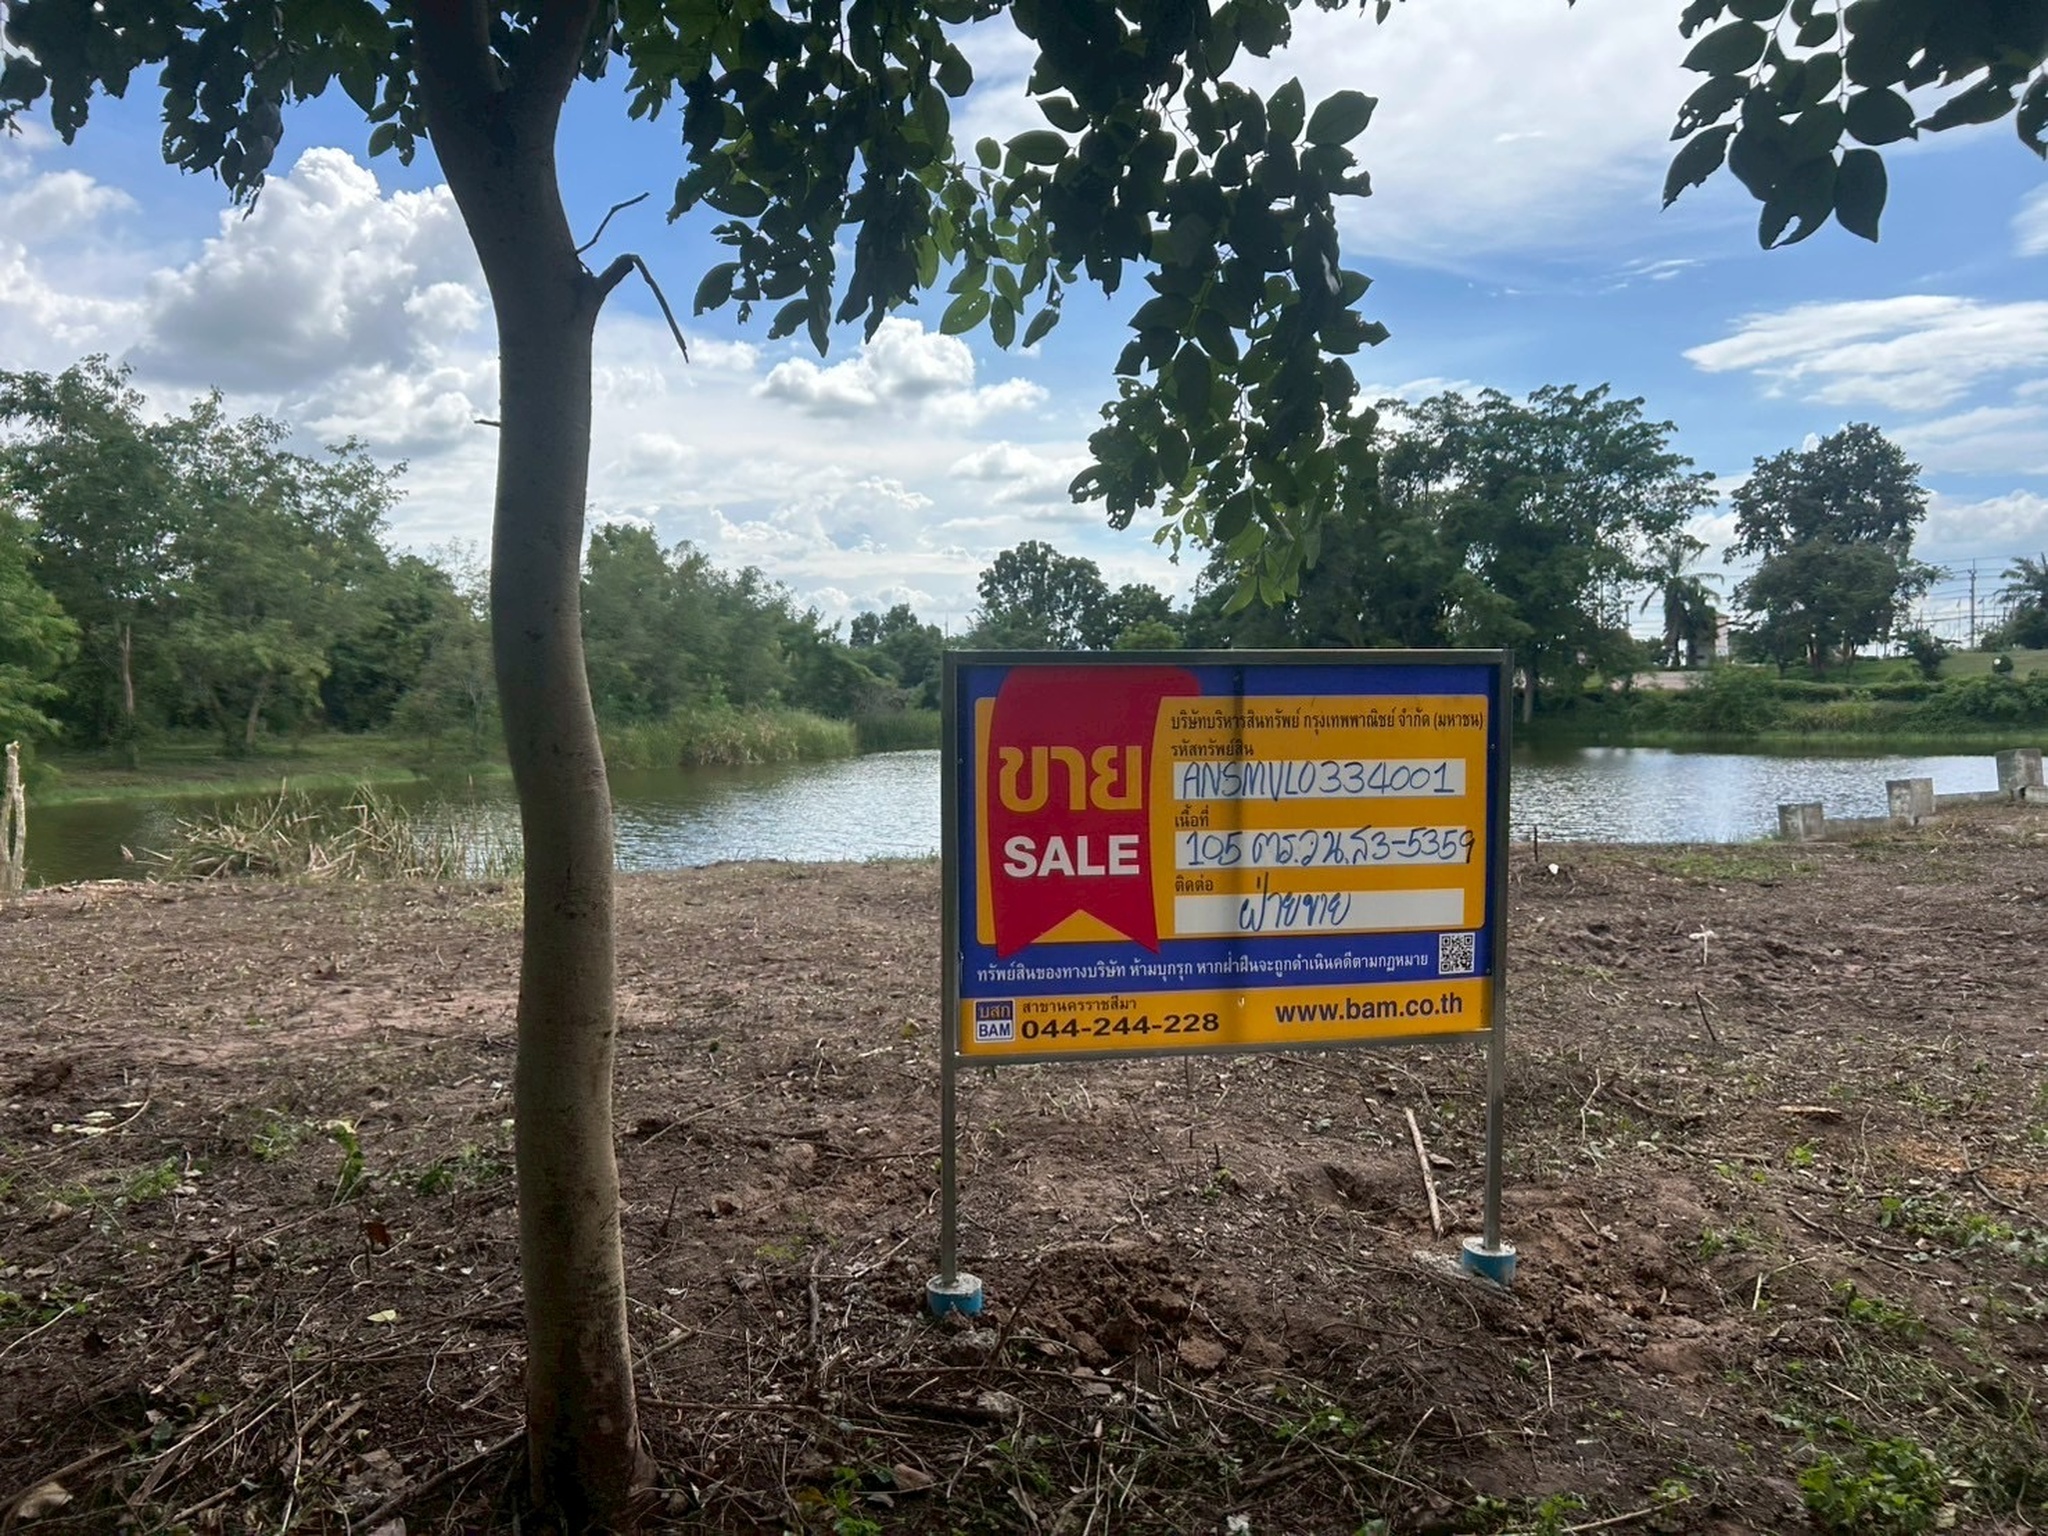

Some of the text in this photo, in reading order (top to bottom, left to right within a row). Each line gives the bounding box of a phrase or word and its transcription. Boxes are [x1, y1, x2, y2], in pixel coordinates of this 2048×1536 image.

[1303, 707, 1396, 735] กรุงเทพพาณิชย์
[1400, 709, 1430, 728] จำกัด
[1433, 711, 1484, 731] (มหาชน)
[1171, 738, 1254, 757] รหัสทรัพย์สิน
[998, 744, 1142, 813] ขาย
[1174, 805, 1210, 828] เนื้อที่
[1003, 834, 1140, 877] SALE
[1186, 831, 1243, 866] 105
[1175, 875, 1214, 893] ติดต่อ
[1239, 872, 1352, 932] ฝ่ายขาย
[976, 960, 1126, 982] ทรัพย์สินของทางบริษัท
[1130, 957, 1193, 983] ห้ามบุกรุก
[1022, 996, 1137, 1014] สาขานครราชสีมา
[1275, 992, 1463, 1023] www.bam.co.th
[978, 1022, 1011, 1038] BAM
[1021, 1012, 1220, 1040] 044-244-228
